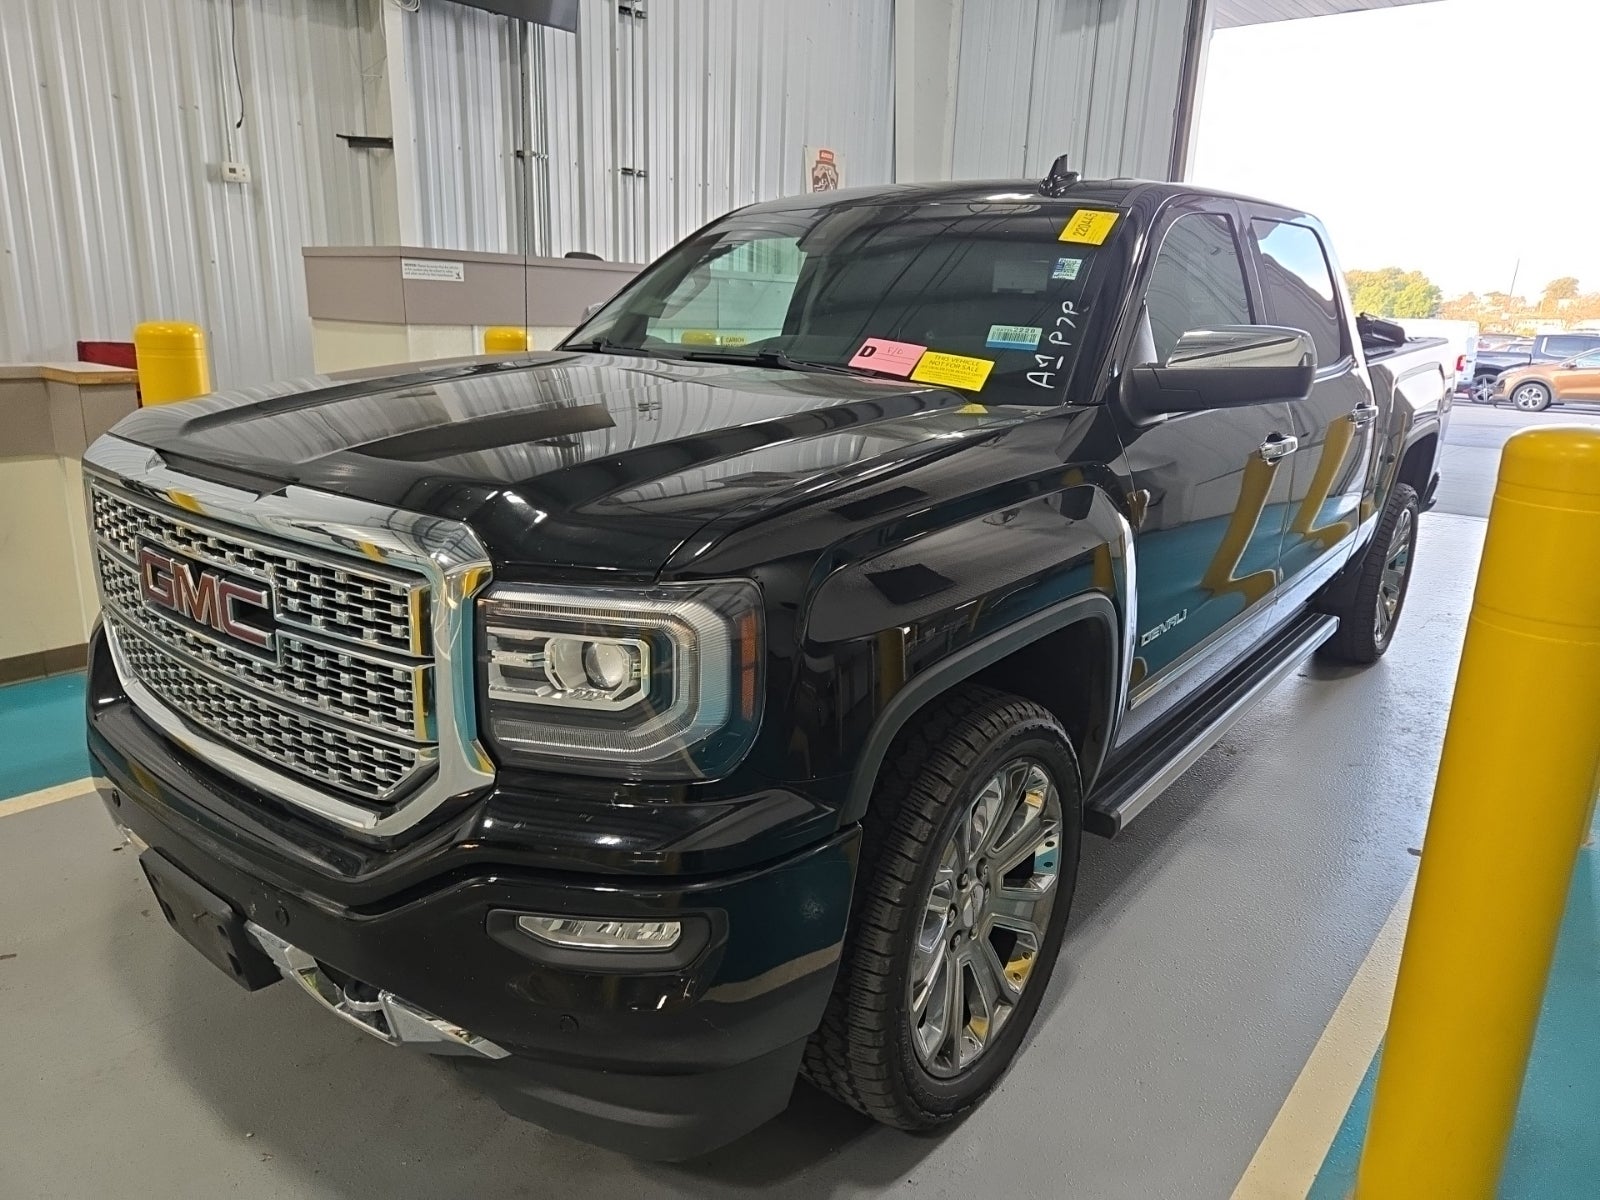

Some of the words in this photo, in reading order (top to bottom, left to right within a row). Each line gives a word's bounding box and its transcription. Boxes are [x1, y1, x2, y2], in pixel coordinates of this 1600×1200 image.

[858, 345, 877, 357] D
[929, 359, 945, 368] NOT
[945, 362, 961, 370] FOR
[962, 364, 979, 373] SALE
[934, 354, 950, 362] THIS
[951, 357, 980, 367] VEHICLE
[140, 546, 276, 652] GMC
[1141, 608, 1188, 647] DENALI
